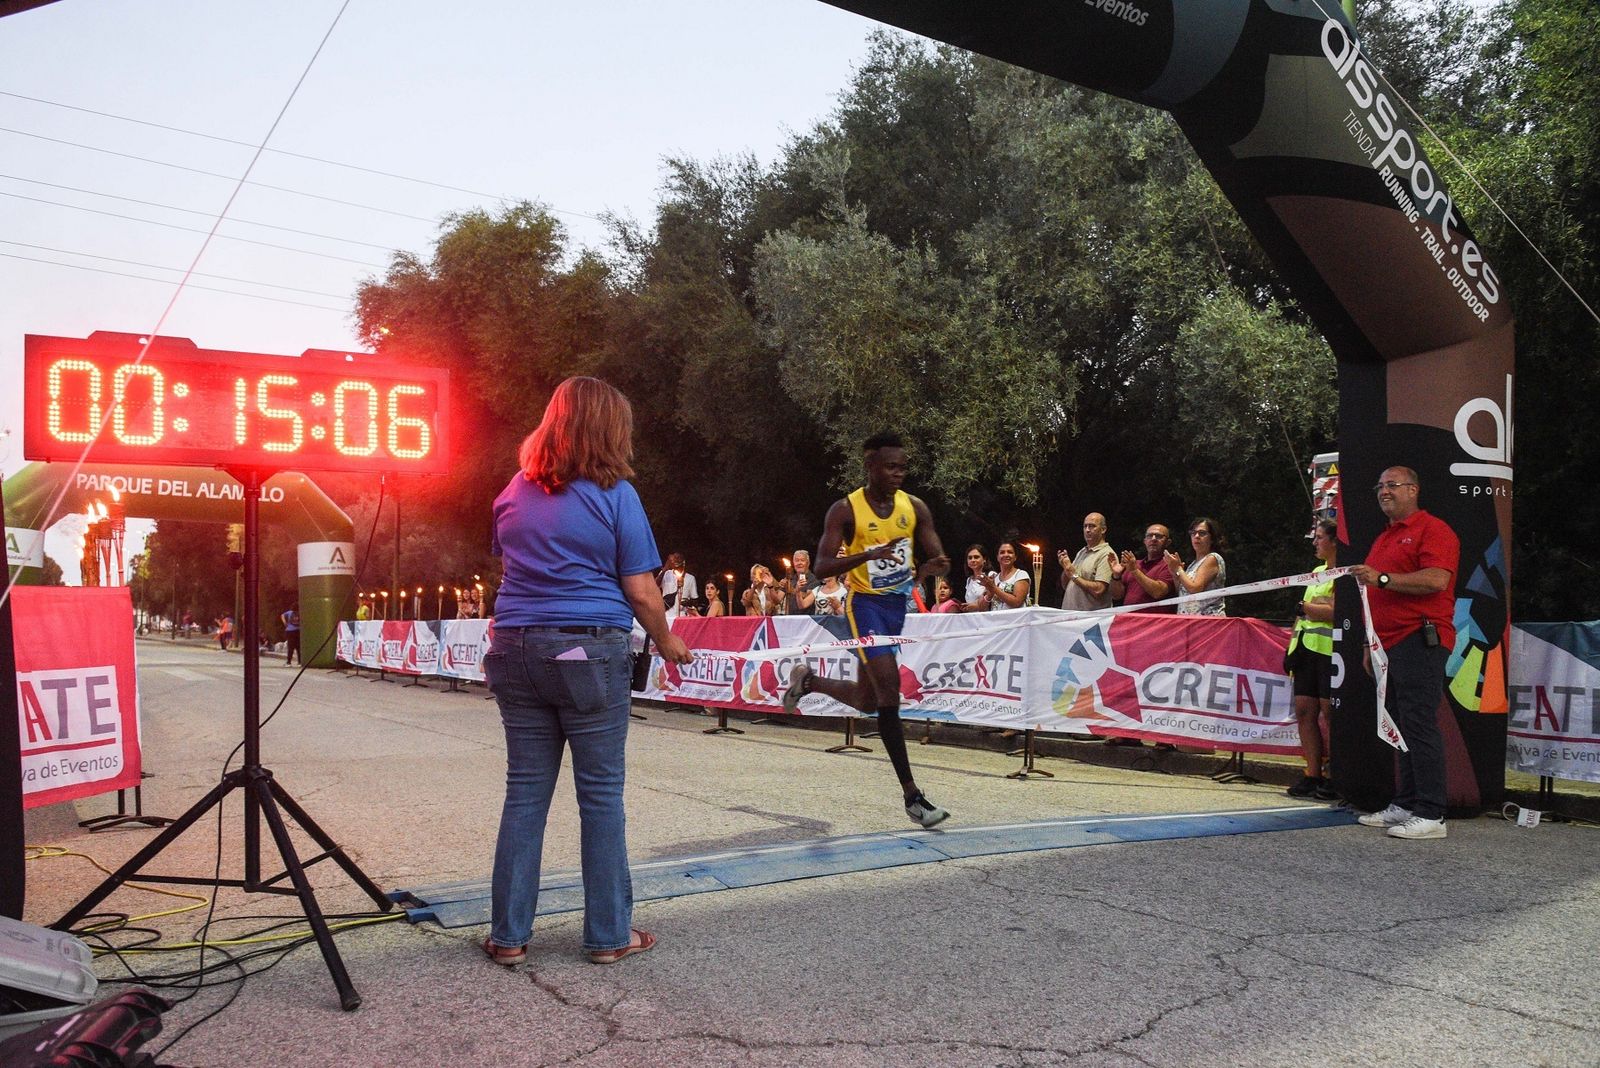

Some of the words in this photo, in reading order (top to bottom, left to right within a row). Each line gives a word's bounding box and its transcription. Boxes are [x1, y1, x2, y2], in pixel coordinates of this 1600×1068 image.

[1343, 109, 1377, 161] TIENDA
[1379, 165, 1420, 223] RUNNING
[1421, 226, 1446, 265] TRAIL
[1447, 267, 1489, 322] OUTDOOR
[76, 473, 153, 495] PARQUE
[157, 479, 192, 497] DEL
[196, 482, 285, 503] ALAMLO
[20, 675, 116, 743] ATE
[1142, 666, 1294, 718] CREAT
[1145, 715, 1185, 729] Acción
[1189, 719, 1238, 737] Creativa
[1242, 729, 1258, 739] de
[40, 761, 58, 779] de
[60, 755, 118, 776] Eventos
